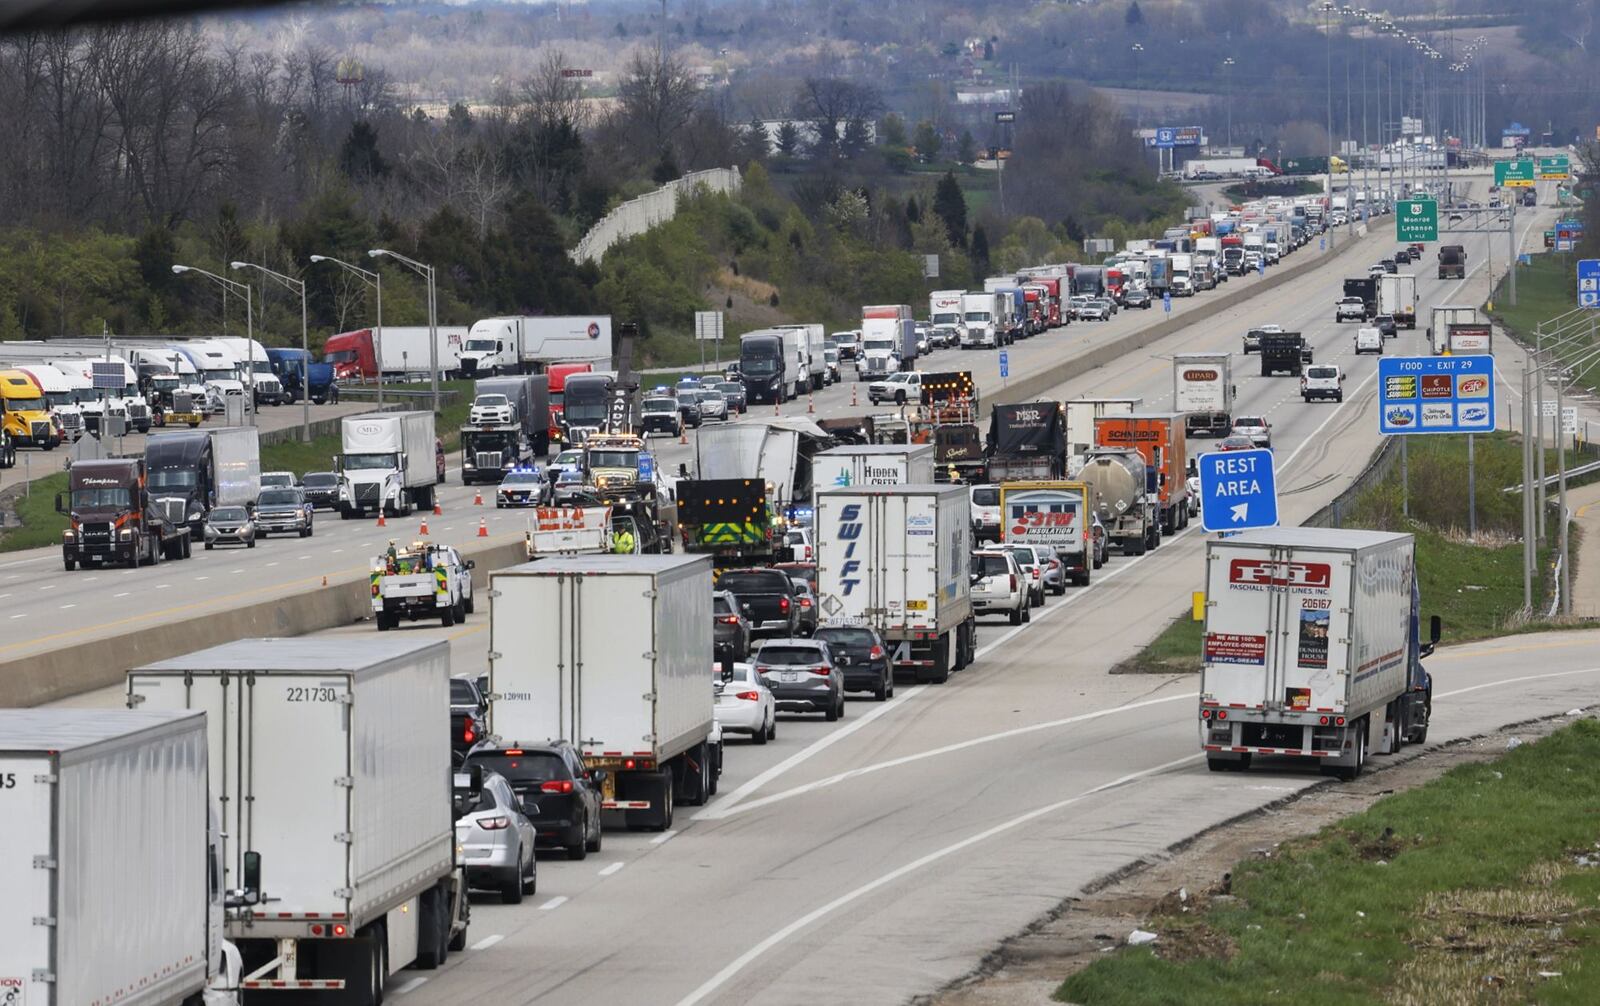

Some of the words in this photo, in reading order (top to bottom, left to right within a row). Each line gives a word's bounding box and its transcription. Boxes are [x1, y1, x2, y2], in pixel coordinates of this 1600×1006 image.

[1400, 362, 1422, 370] FOOD
[1437, 361, 1455, 369] EXIT
[1461, 360, 1473, 369] 29
[864, 466, 898, 478] HIDDEN
[1215, 457, 1257, 475] REST
[82, 478, 119, 486] Thompson
[1216, 480, 1262, 497] AREA
[838, 504, 863, 596] SWIFT
[1230, 584, 1264, 592] PASCHALL
[1302, 598, 1332, 609] 206167
[287, 687, 336, 702] 221730
